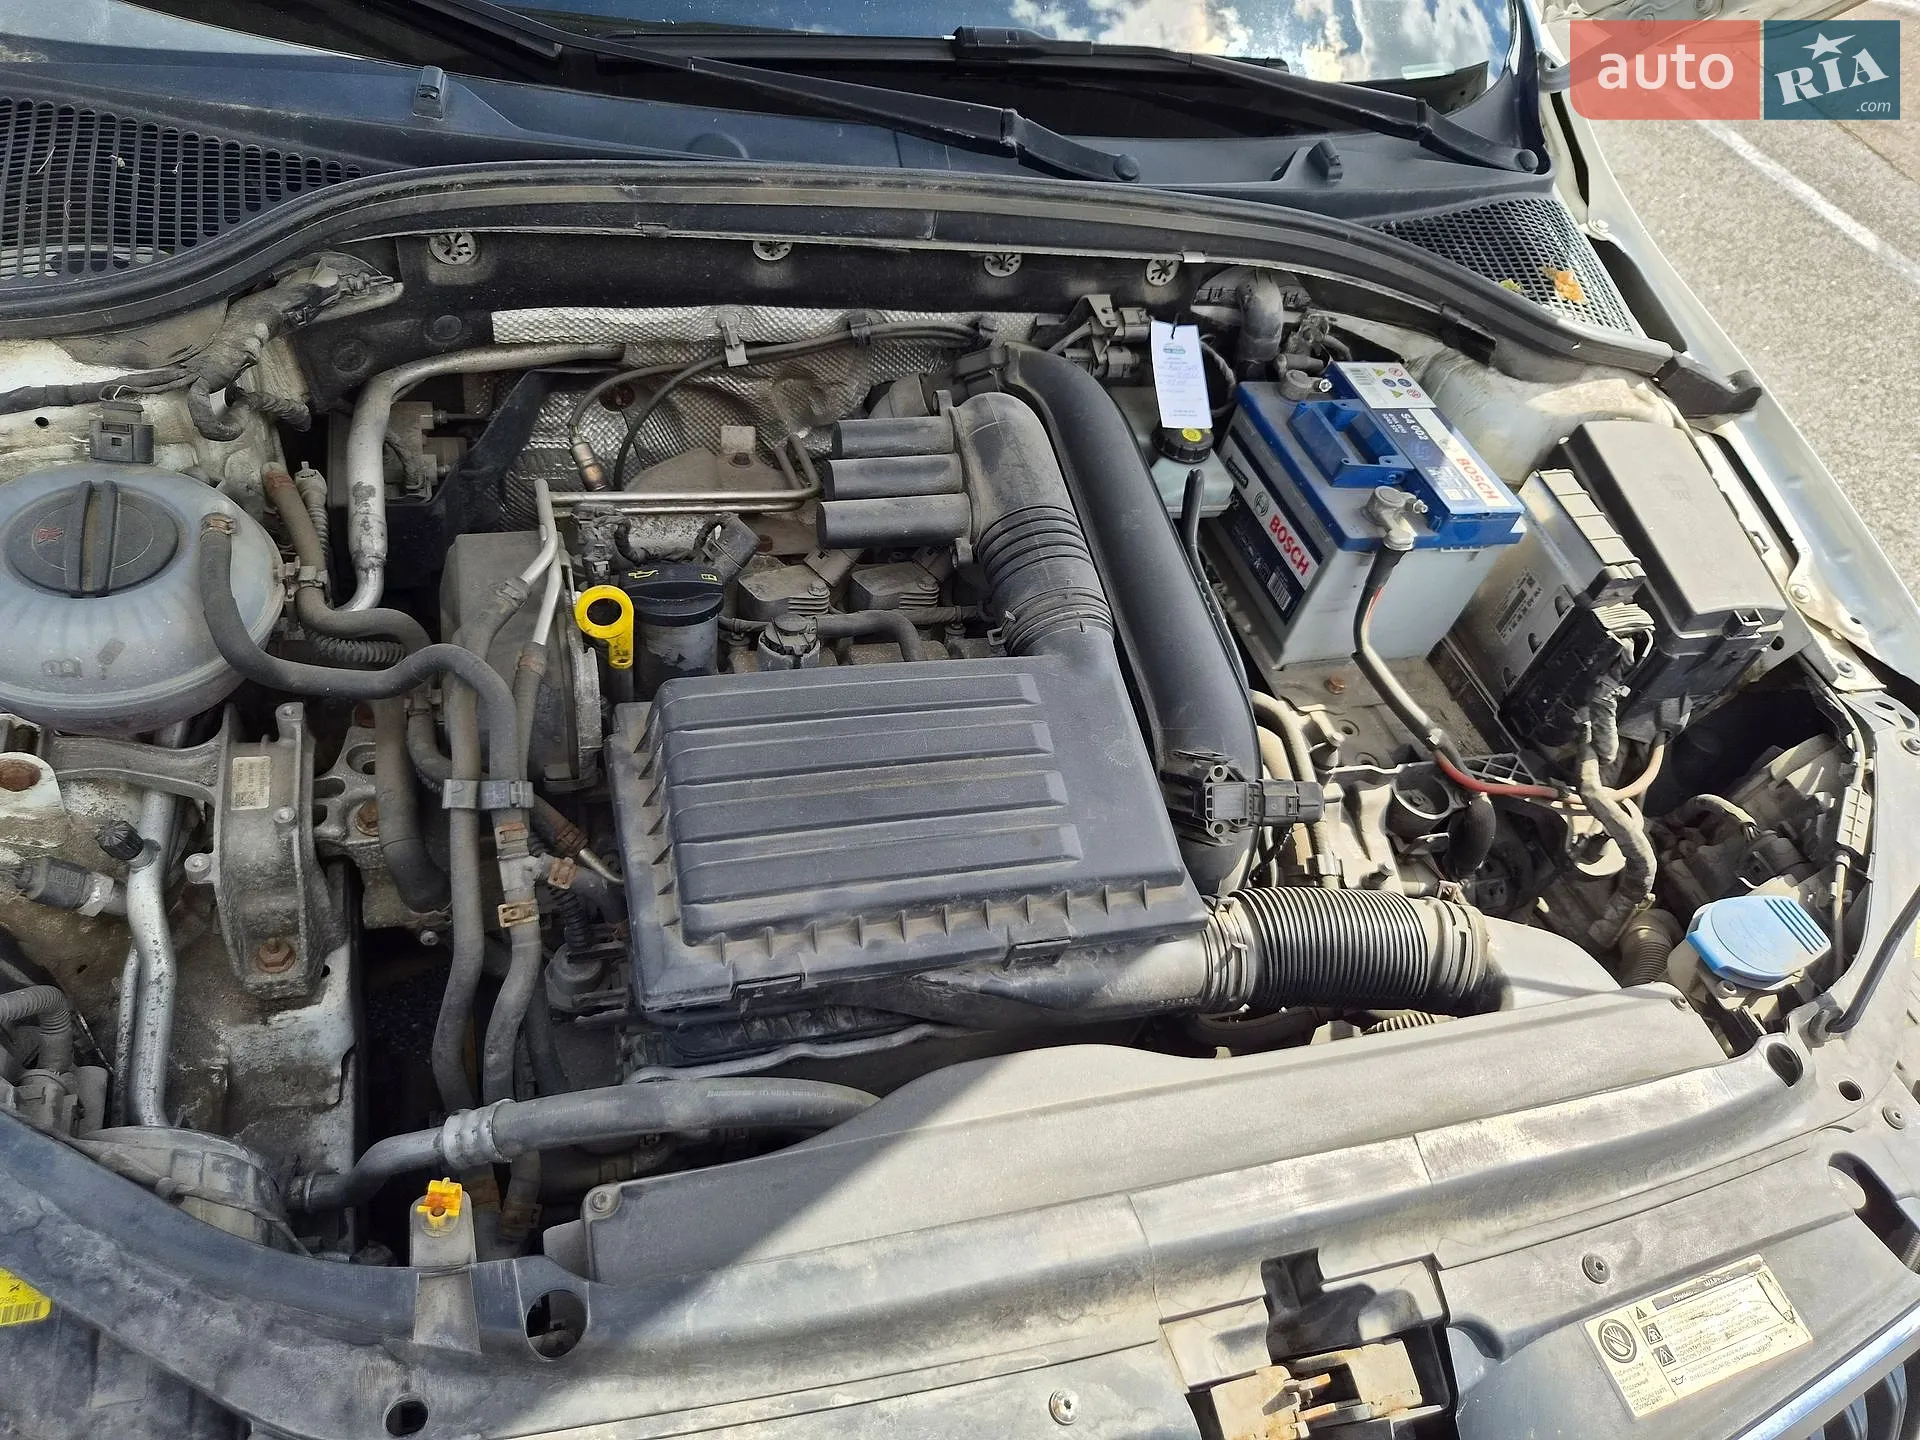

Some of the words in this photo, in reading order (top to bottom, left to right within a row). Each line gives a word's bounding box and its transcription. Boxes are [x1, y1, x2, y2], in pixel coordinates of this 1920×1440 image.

[1400, 413, 1416, 424] S4
[1456, 457, 1499, 499] BOSCH
[1269, 514, 1309, 577] BOSCH
